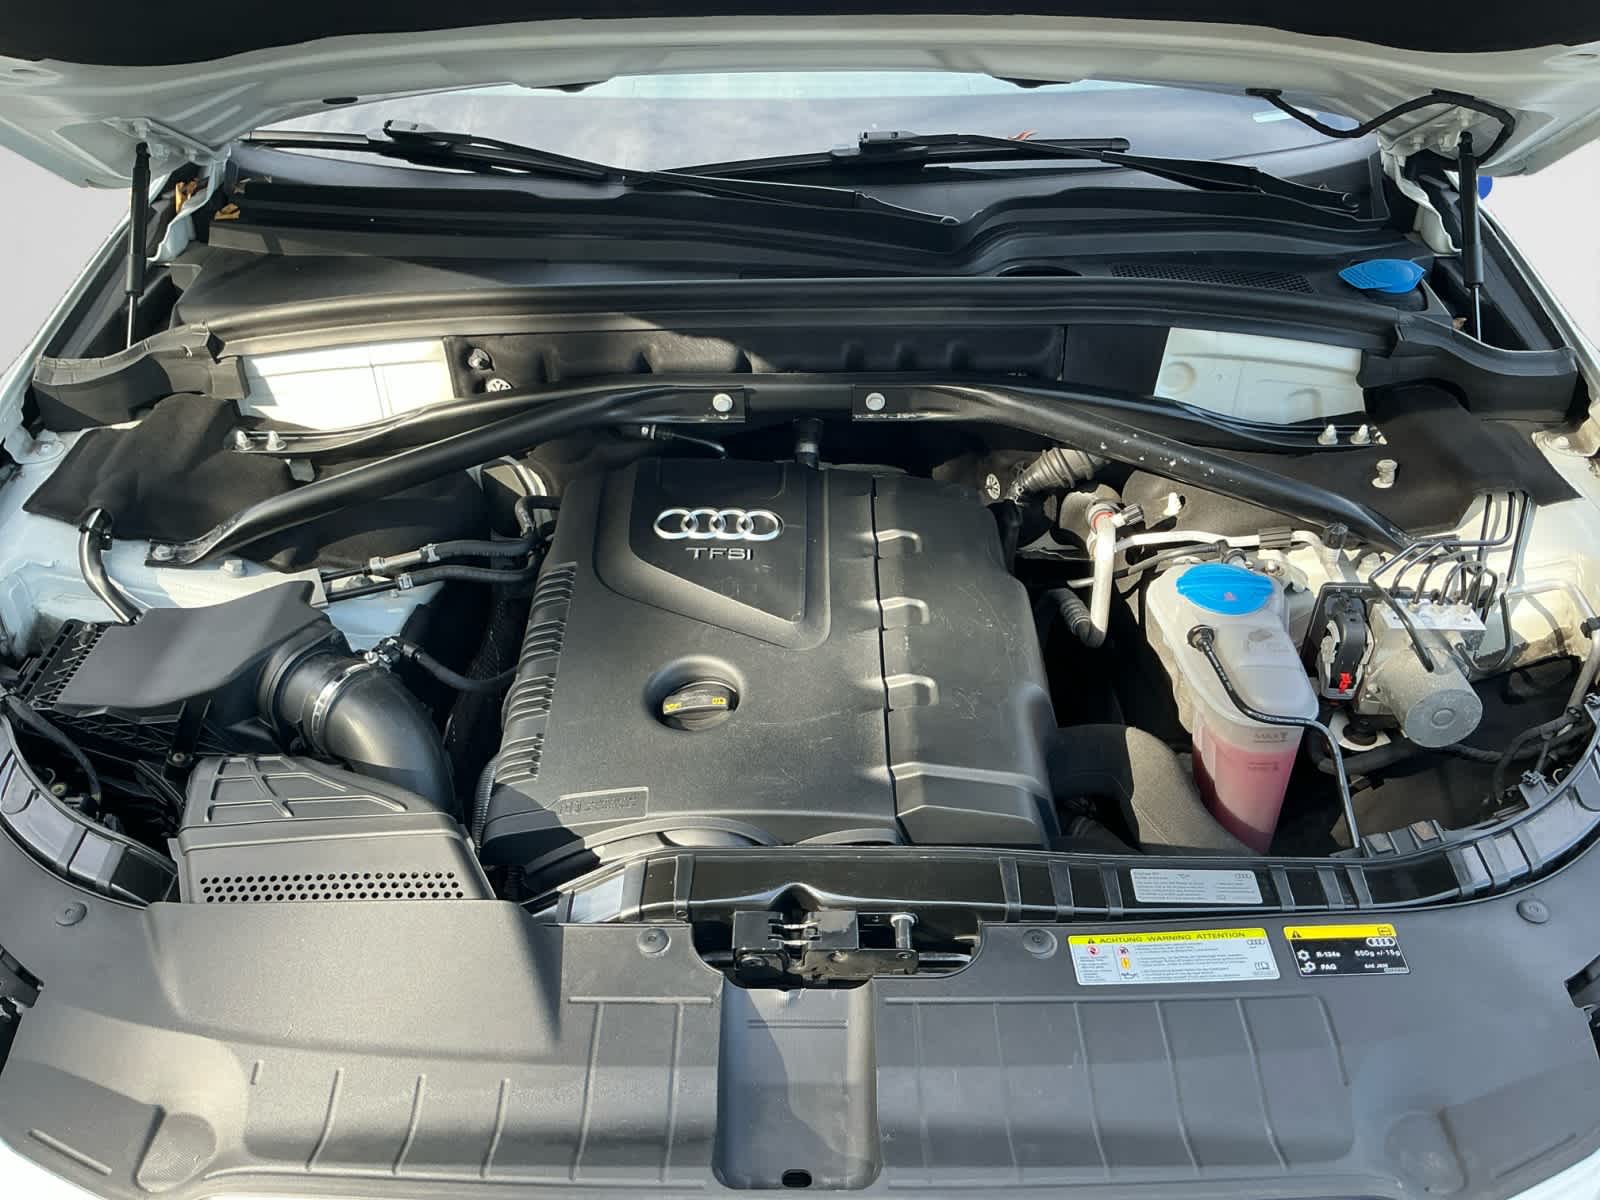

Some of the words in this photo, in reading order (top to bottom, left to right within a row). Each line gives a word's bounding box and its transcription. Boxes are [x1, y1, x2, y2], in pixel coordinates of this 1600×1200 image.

[685, 547, 752, 561] TFSI
[1099, 935, 1143, 944] ACHTUNG
[1147, 934, 1192, 942] WARNING
[1196, 931, 1246, 940] ATTENTION
